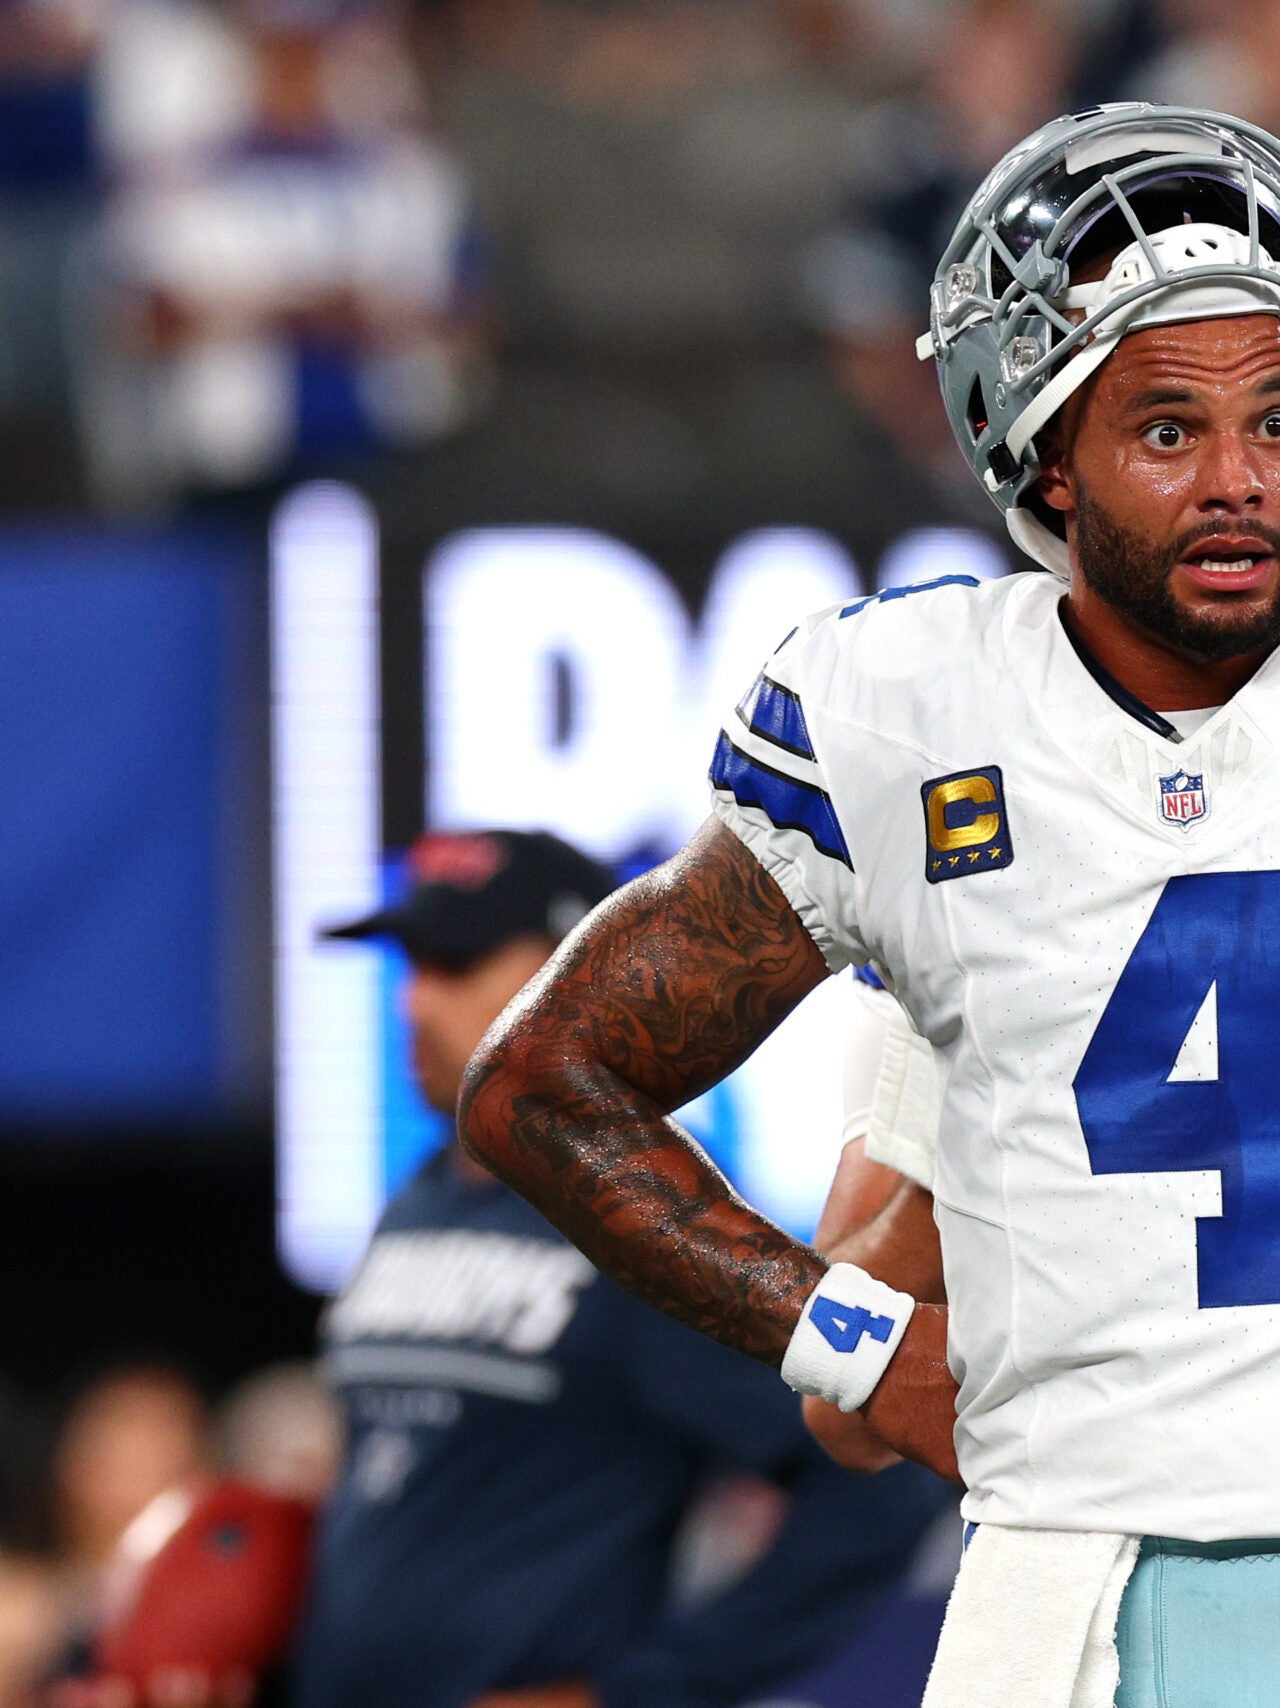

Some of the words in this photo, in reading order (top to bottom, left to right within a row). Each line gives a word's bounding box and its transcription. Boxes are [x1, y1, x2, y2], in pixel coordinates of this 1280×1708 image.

[927, 776, 1000, 852] C
[1165, 793, 1202, 819] NFL
[809, 1295, 895, 1353] 4
